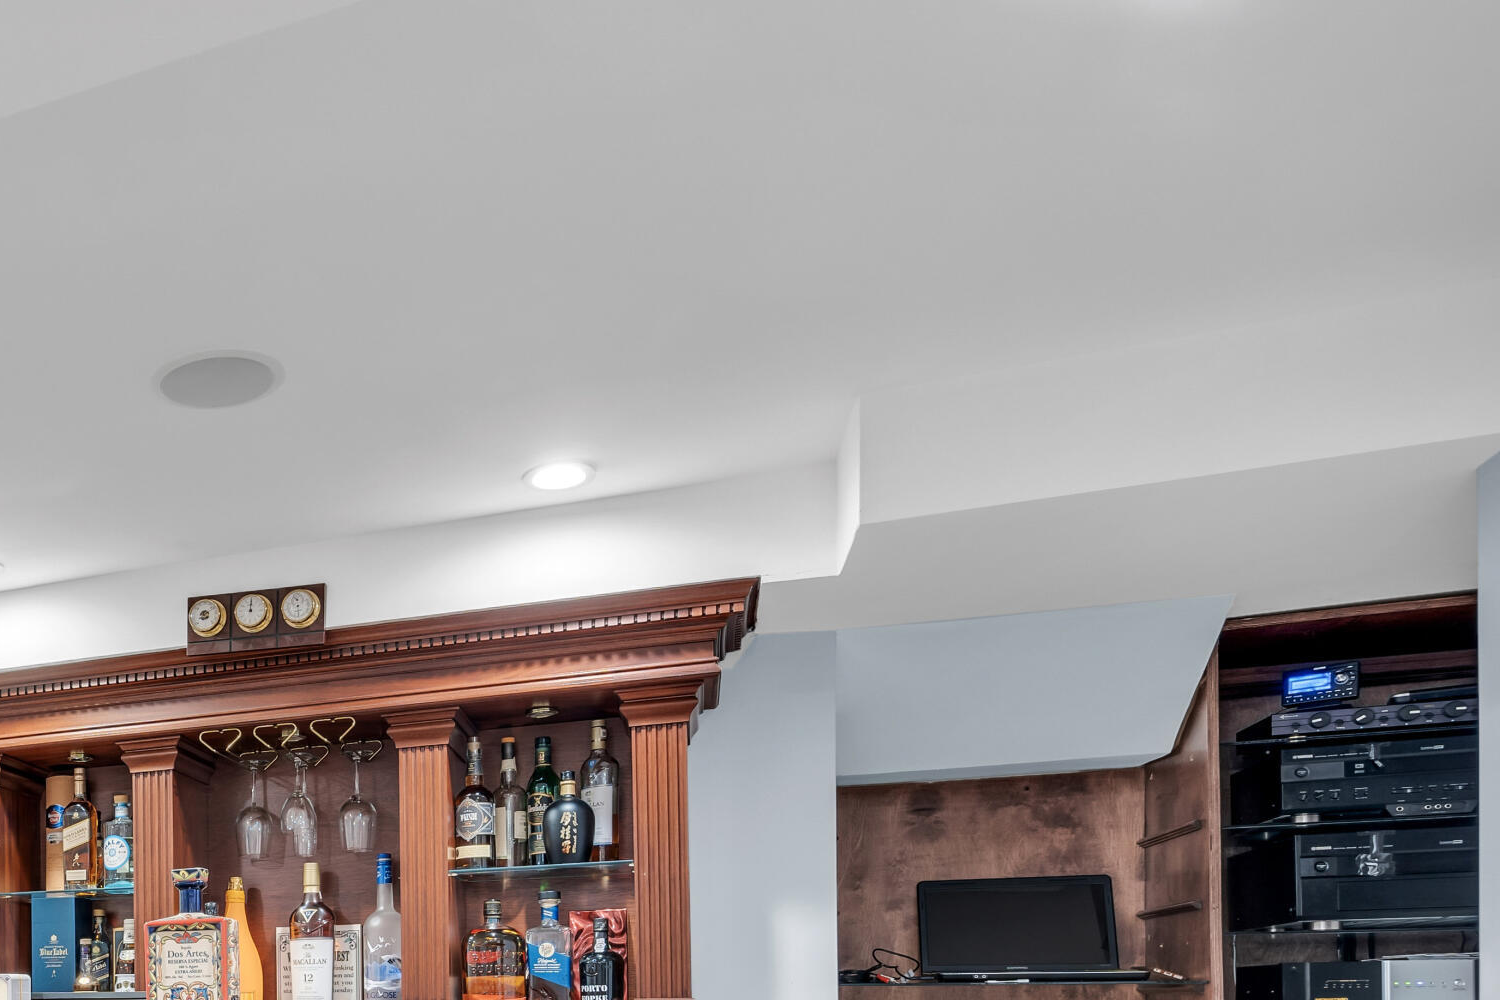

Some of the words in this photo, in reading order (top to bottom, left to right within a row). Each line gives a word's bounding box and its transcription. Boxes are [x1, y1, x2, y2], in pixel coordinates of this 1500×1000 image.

[39, 947, 53, 956] Blue
[53, 947, 69, 956] Label
[292, 958, 328, 966] MACALLAN
[303, 973, 314, 982] 12
[581, 984, 608, 993] PORTO
